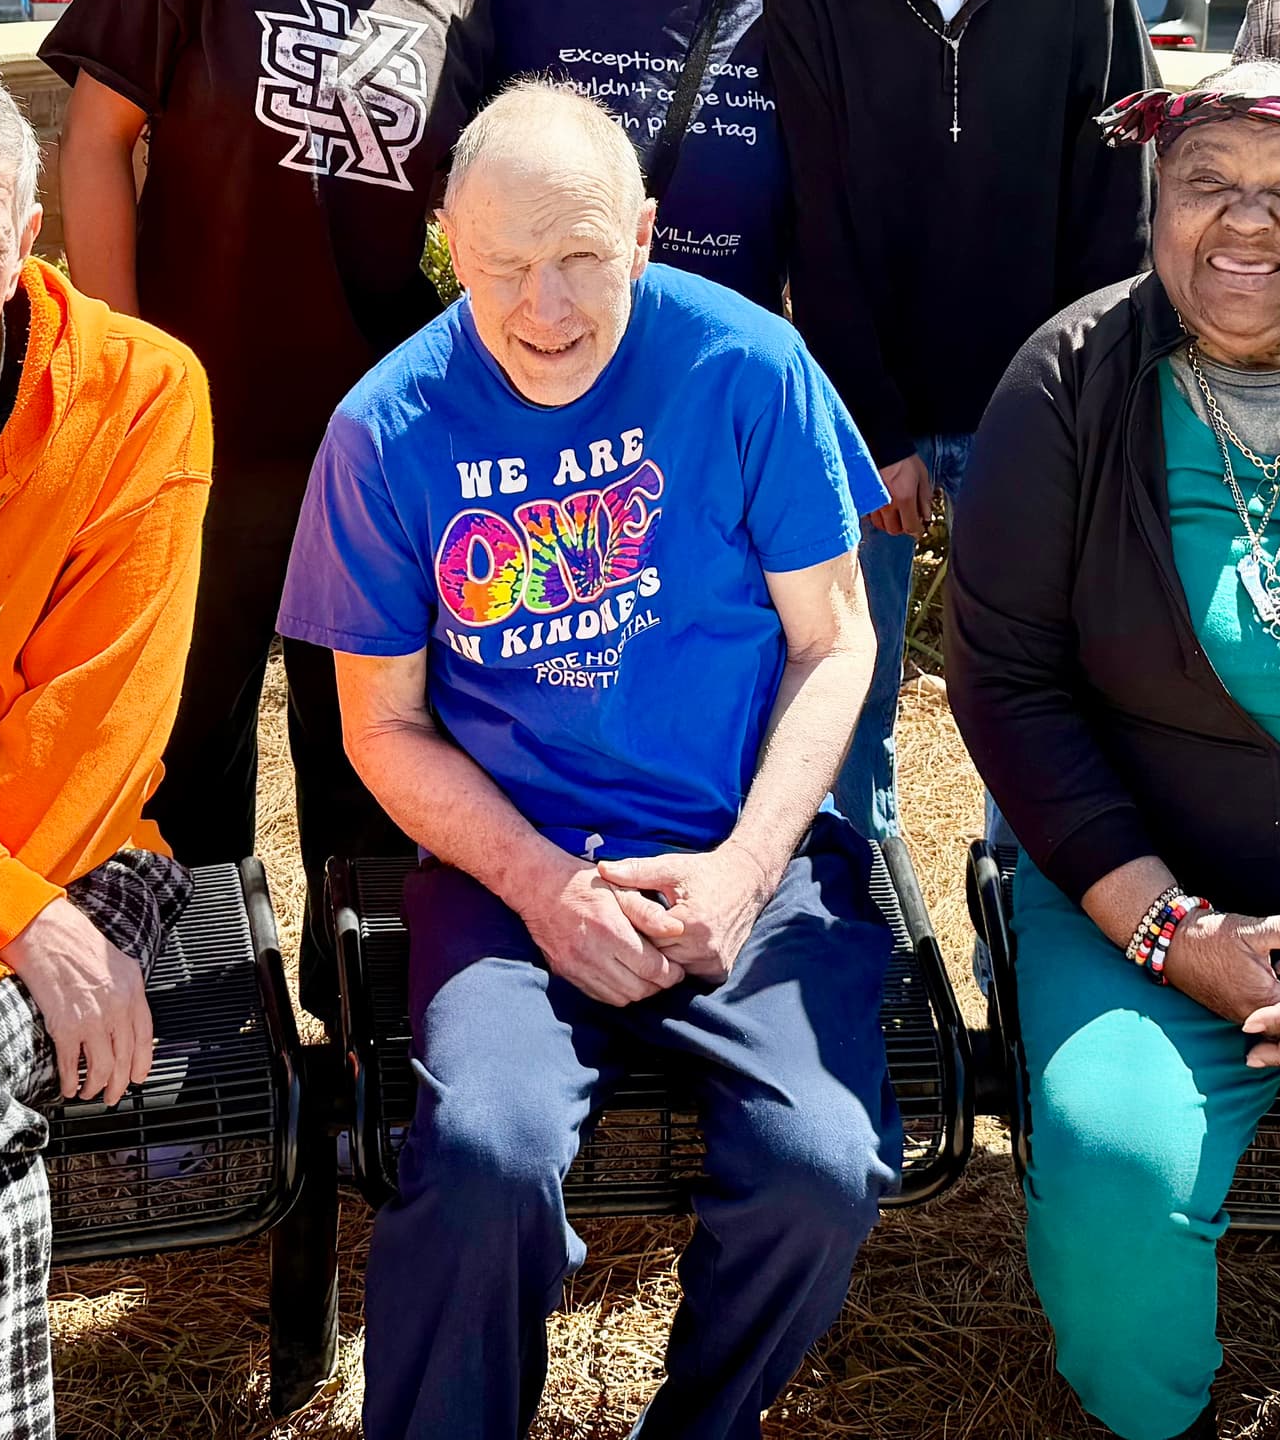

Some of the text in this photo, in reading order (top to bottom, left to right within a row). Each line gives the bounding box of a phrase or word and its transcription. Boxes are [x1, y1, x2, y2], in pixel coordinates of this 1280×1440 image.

[558, 48, 760, 80] Exception care
[725, 90, 776, 112] with
[711, 117, 757, 146] tag
[653, 225, 742, 247] VILLAGE
[662, 242, 737, 257] COMMUNITY
[456, 427, 644, 499] WE ARE
[434, 459, 664, 627] ONE
[445, 628, 485, 664] IN
